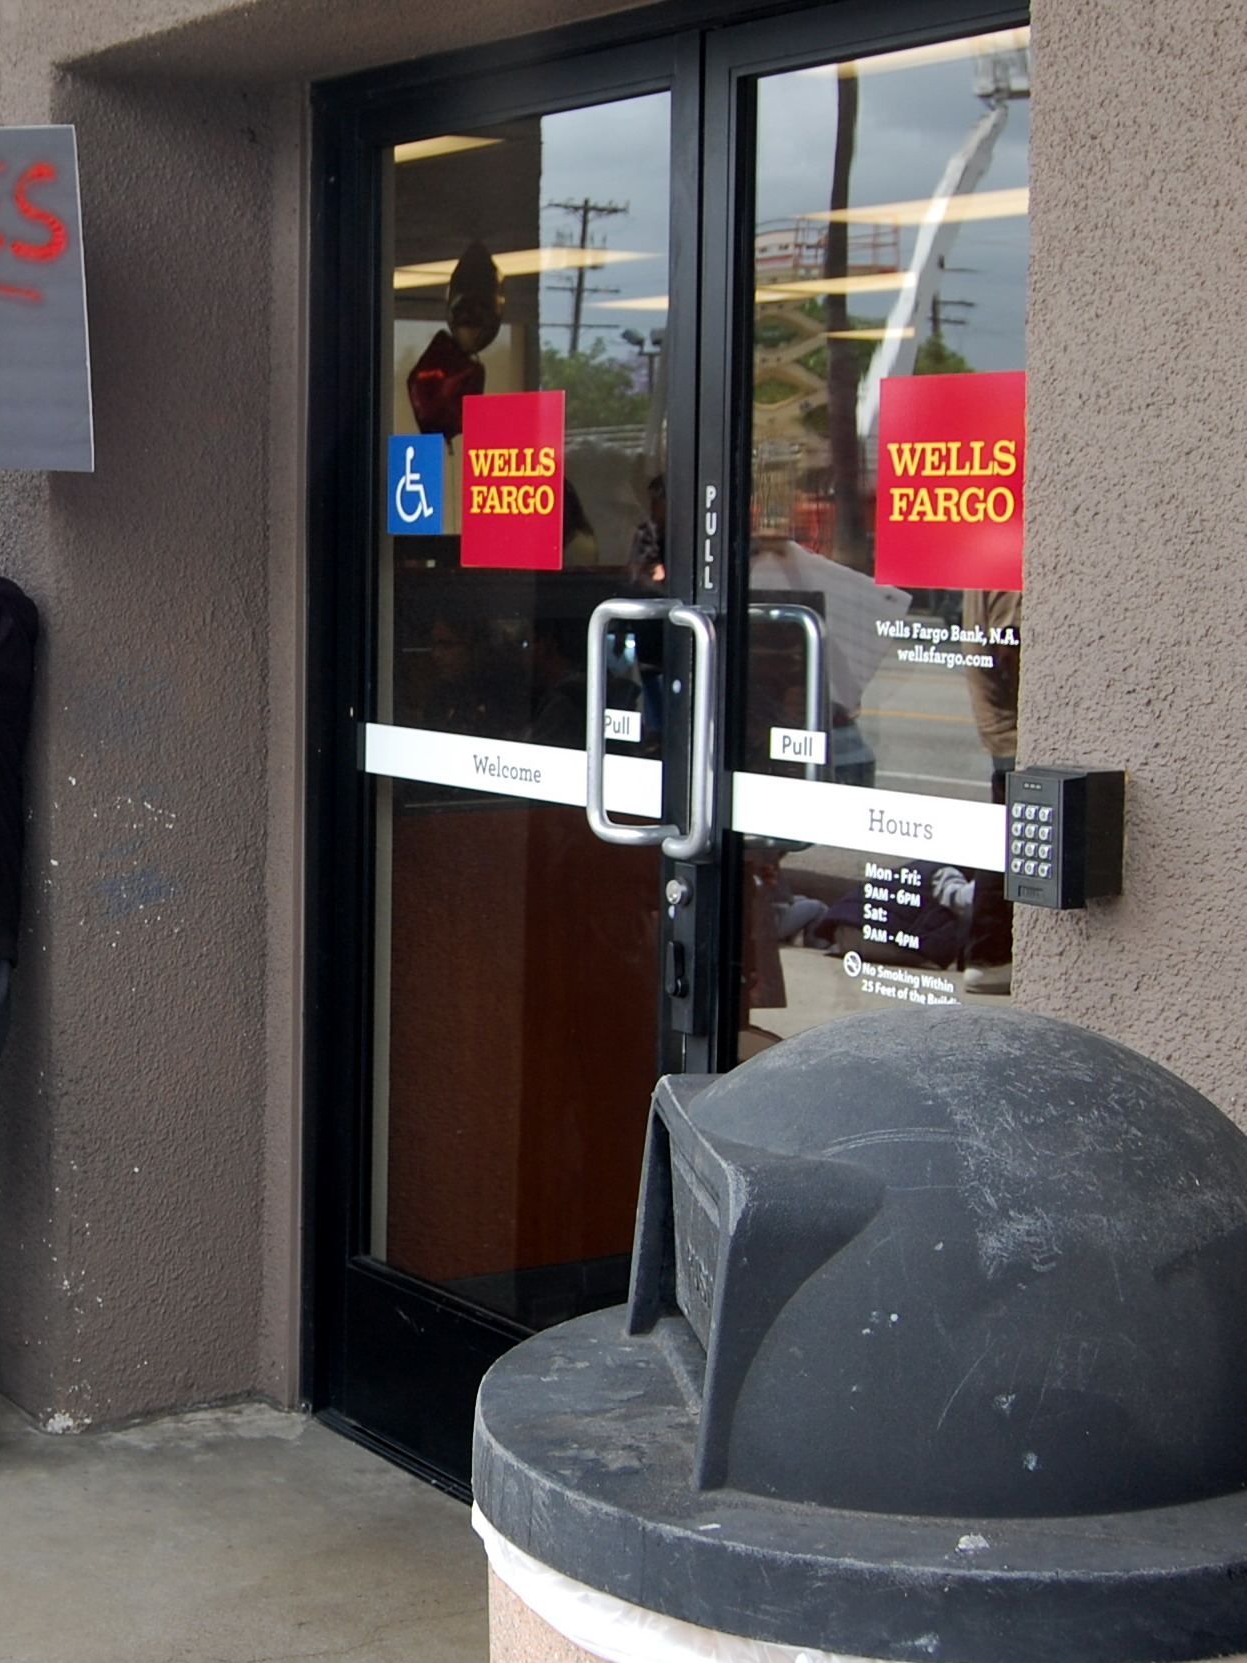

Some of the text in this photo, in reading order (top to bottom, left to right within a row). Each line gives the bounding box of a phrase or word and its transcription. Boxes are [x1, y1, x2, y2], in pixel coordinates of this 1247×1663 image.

[469, 447, 556, 477] WELLS
[887, 440, 1017, 476] WELLS
[470, 485, 555, 515] FARGO
[889, 487, 1015, 523] FARGO
[704, 485, 717, 589] PULL
[875, 620, 1019, 646] Wells Fargo Bank, N.A.
[897, 645, 994, 669] wellsfargo.com
[605, 715, 630, 735] Pull
[782, 735, 813, 757] Pull
[472, 754, 541, 783] Welcome
[868, 808, 933, 840] Hours
[865, 862, 892, 881] Mon
[901, 868, 922, 887] Fri:
[864, 883, 888, 901] 9AM
[896, 889, 921, 907] 6PM
[863, 903, 888, 922] Sat:
[862, 924, 888, 943] 9AM
[895, 931, 919, 949] 4PM
[862, 962, 954, 993] No Smoking Within
[862, 979, 874, 993] 25
[875, 982, 896, 998] Feet
[897, 988, 908, 1000] of
[909, 990, 926, 1004] the
